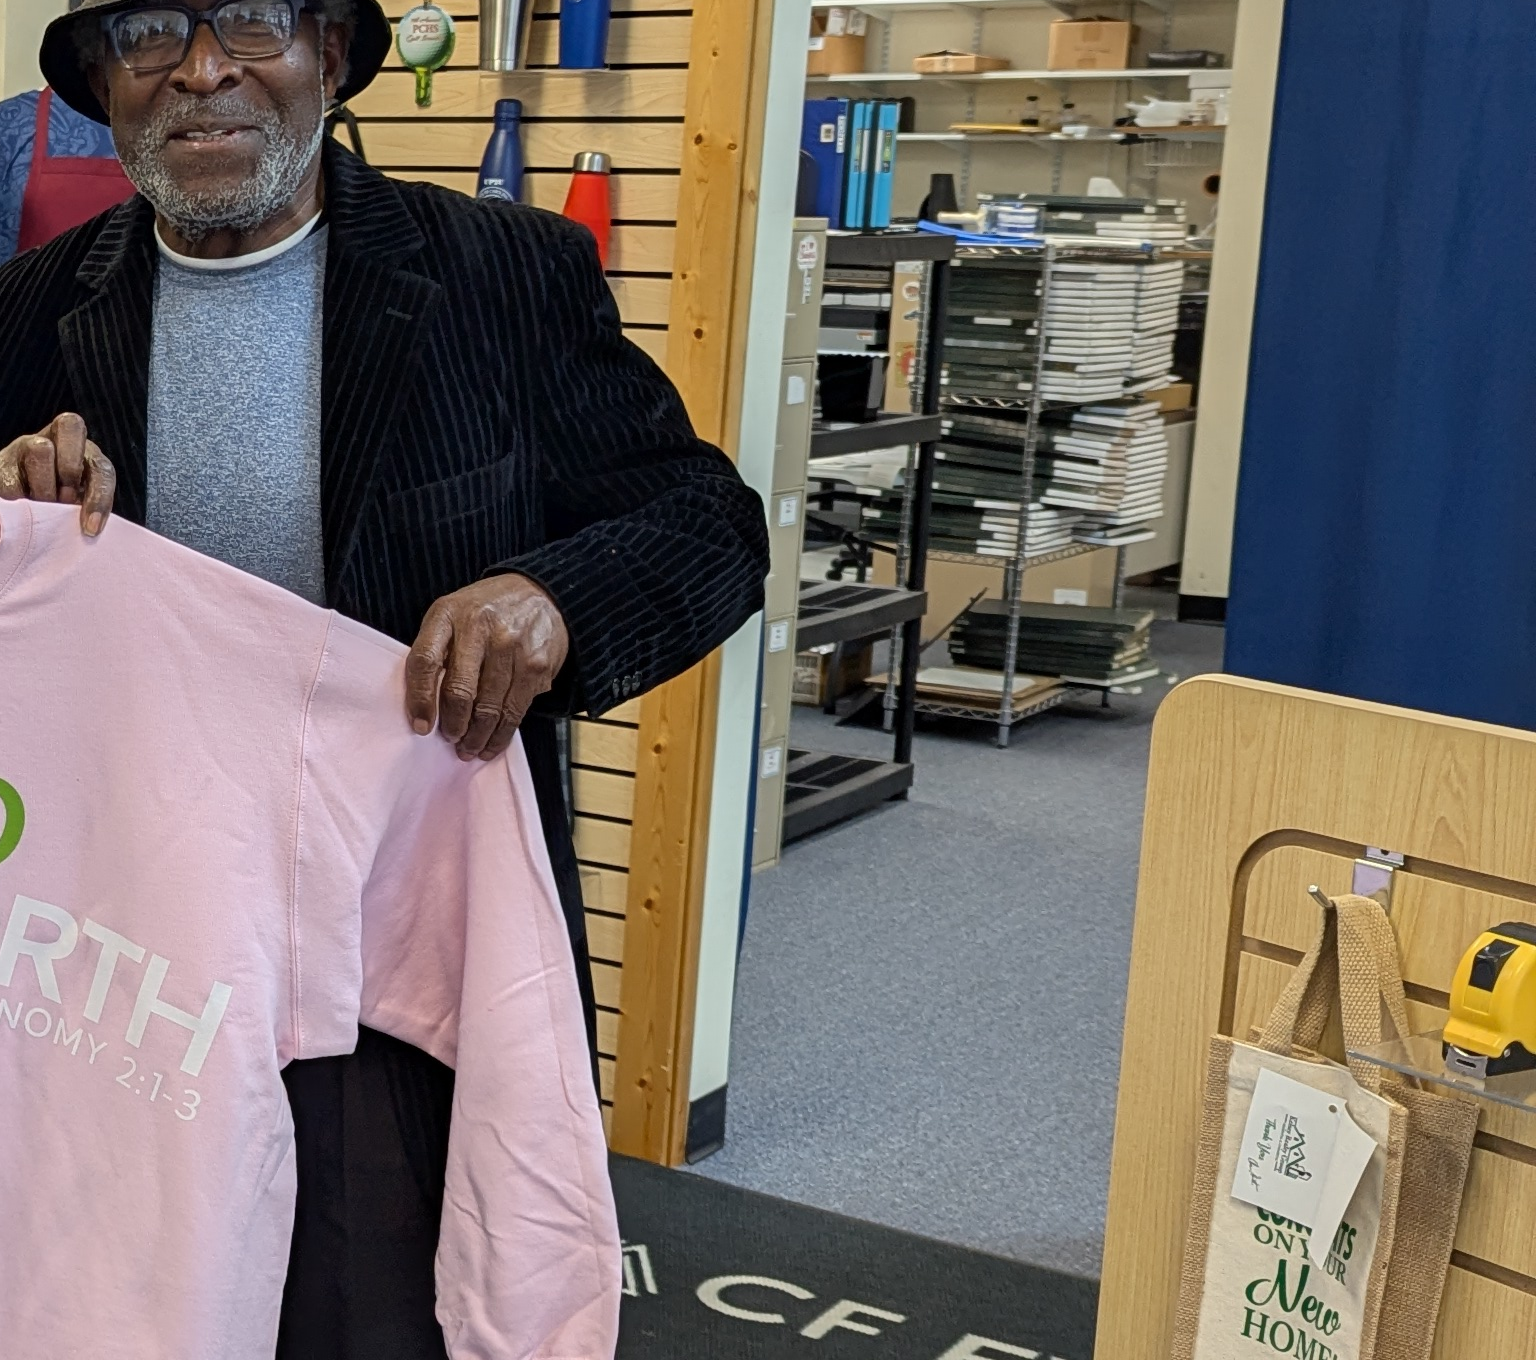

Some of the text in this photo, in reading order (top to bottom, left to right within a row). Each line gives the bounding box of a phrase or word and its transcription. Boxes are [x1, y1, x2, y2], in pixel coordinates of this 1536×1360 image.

[413, 24, 439, 33] PCHS
[115, 1056, 203, 1123] 2:1-3
[1253, 1223, 1295, 1254] ON
[1297, 1237, 1347, 1286] YUR
[696, 1274, 908, 1340] CF
[1245, 1258, 1342, 1336] New
